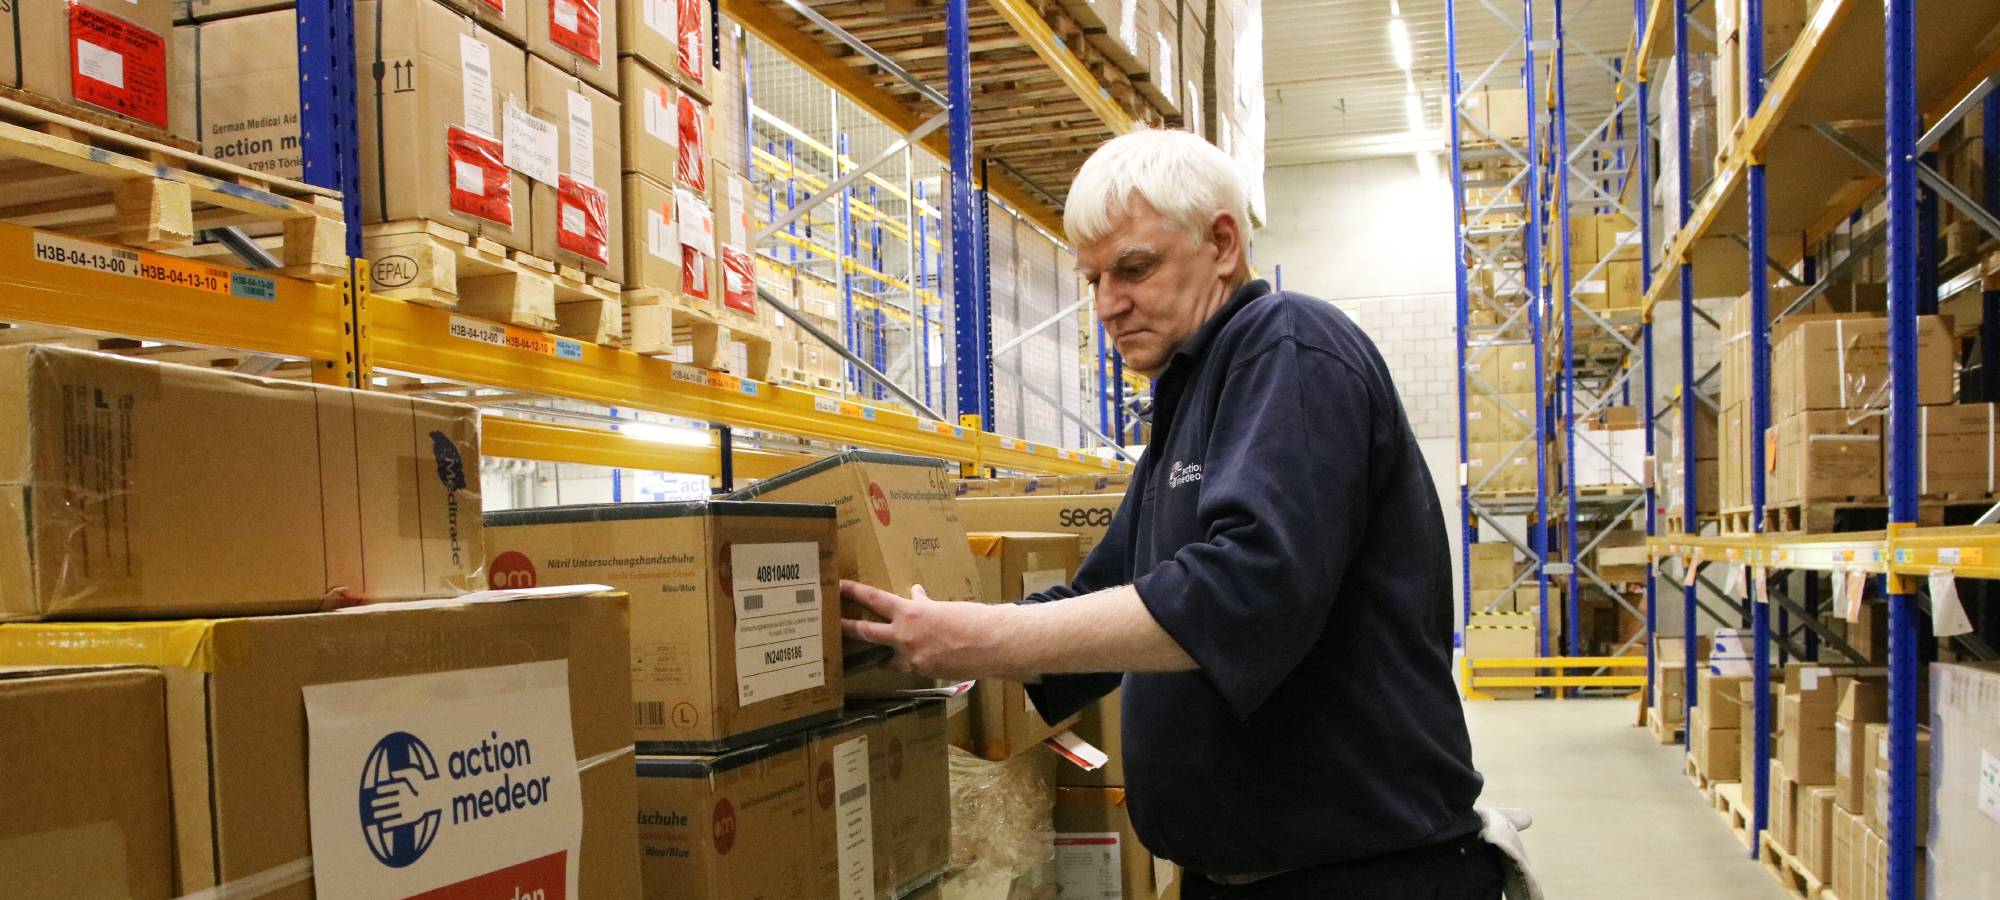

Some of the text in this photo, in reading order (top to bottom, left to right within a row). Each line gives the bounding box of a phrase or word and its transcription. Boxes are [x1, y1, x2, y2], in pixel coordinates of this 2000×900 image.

[212, 113, 297, 134] German Medical Aid
[214, 138, 272, 159] action
[37, 243, 125, 273] H3B-04-13-00
[141, 264, 217, 290] H3B-04-13-10
[377, 262, 410, 280] EPAL
[451, 324, 498, 343] H3B-04-12-00
[506, 335, 548, 353] H3B-04-12-10
[444, 457, 461, 566] Meditrade
[1059, 508, 1112, 527] seca
[547, 553, 695, 569] Nitril Untersuchungshandschuhe
[756, 564, 800, 582] 408104002
[662, 584, 696, 593] Blau/Blue
[448, 731, 531, 780] action
[452, 773, 551, 825] medeor
